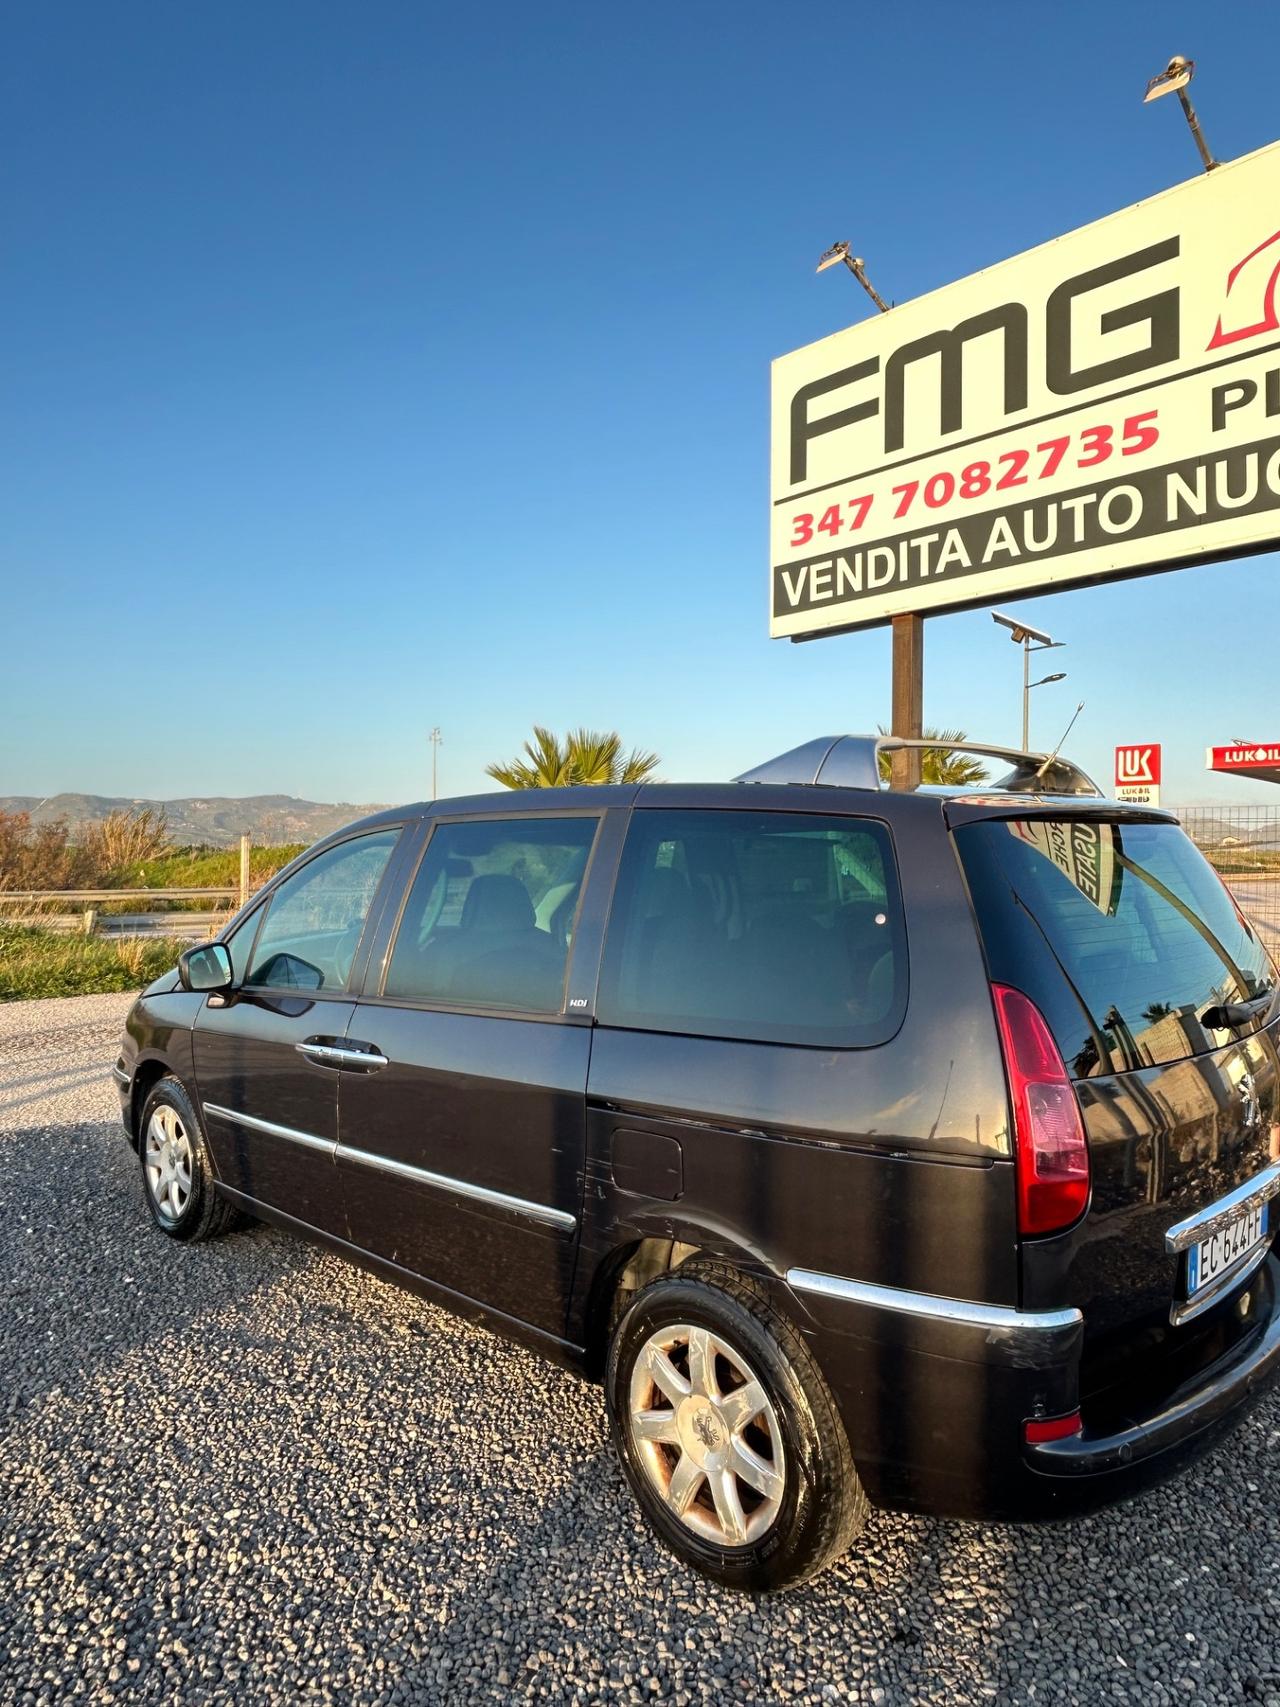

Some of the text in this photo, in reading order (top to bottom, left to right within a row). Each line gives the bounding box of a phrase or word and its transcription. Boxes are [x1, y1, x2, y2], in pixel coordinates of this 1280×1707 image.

[790, 235, 1180, 485] FMG
[781, 532, 973, 606] VENDITA
[982, 485, 1143, 563] AUTO
[790, 409, 1160, 547] 347 7082735
